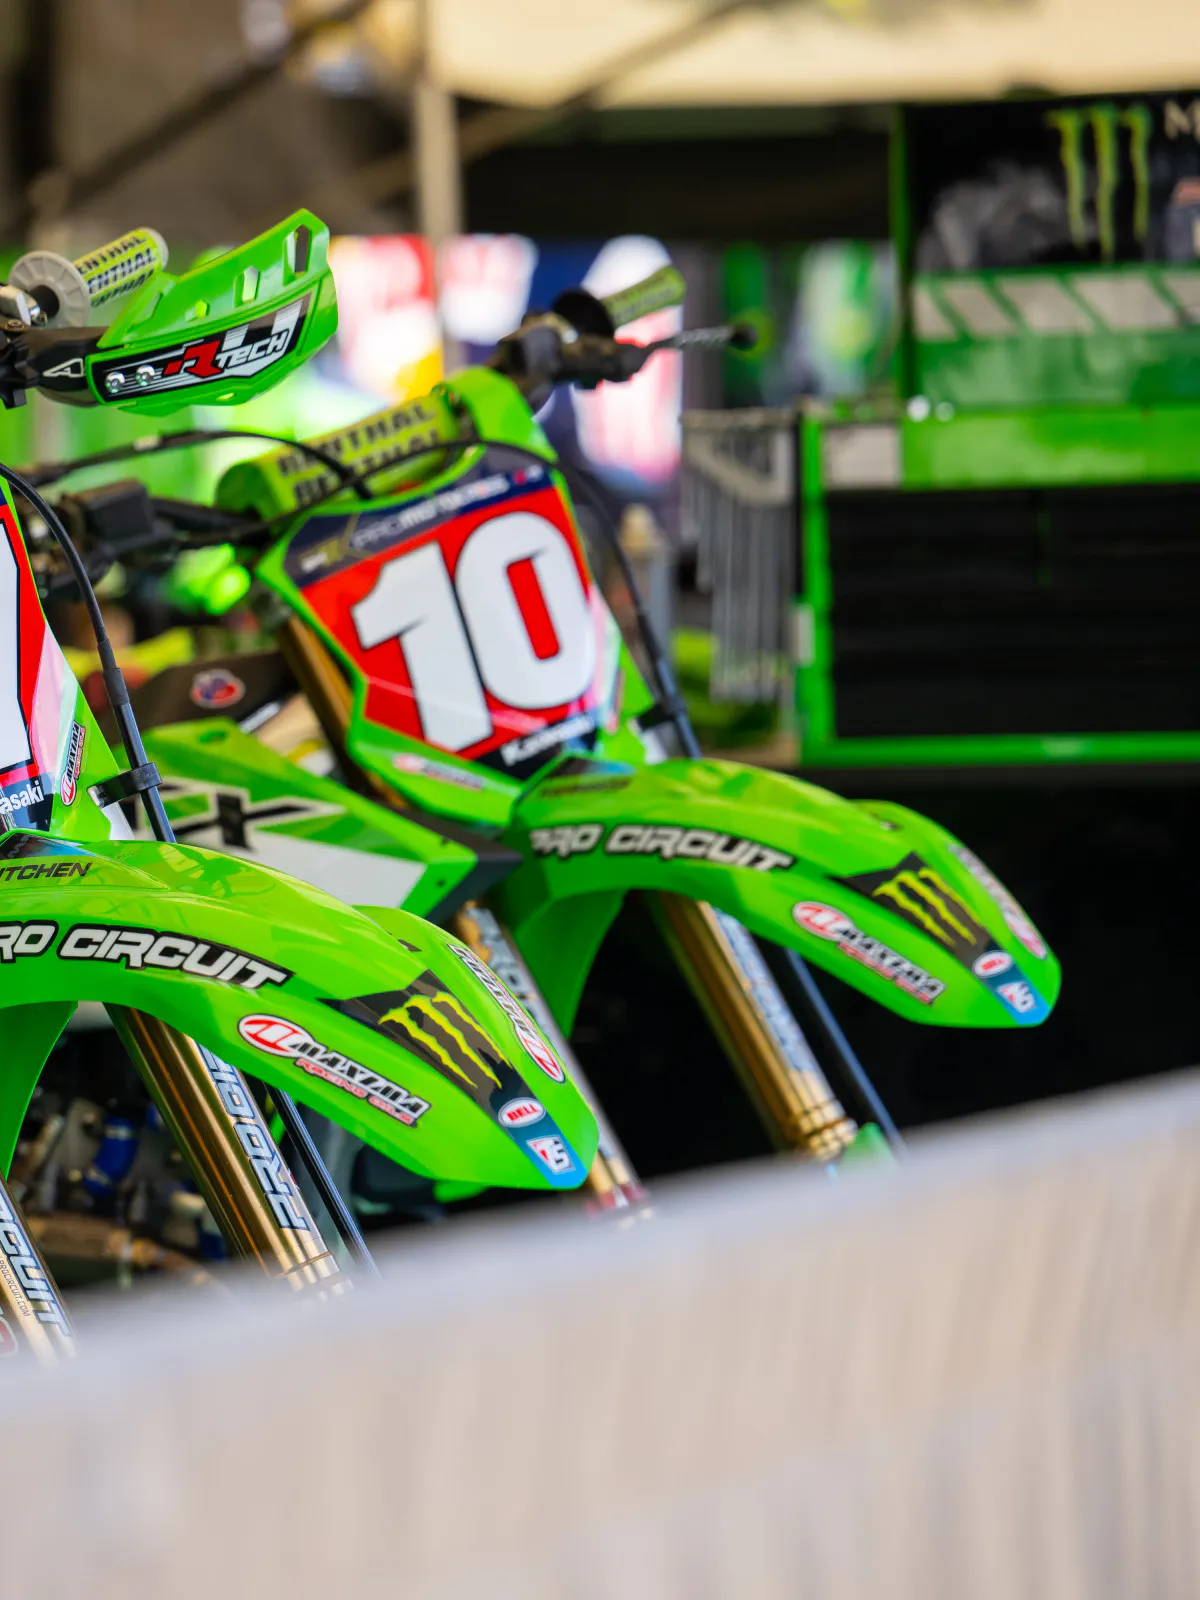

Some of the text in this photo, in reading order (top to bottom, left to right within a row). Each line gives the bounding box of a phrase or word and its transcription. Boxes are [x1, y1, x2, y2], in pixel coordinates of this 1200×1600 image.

[76, 235, 147, 275] ENTHAL
[86, 247, 157, 294] ENTHAL
[351, 510, 597, 752] 10
[605, 825, 795, 871] CIRCUIT
[60, 927, 287, 988] CIRCUIT
[296, 1058, 368, 1099] RACING
[506, 1102, 540, 1121] BELL
[233, 1121, 310, 1231] PRO
